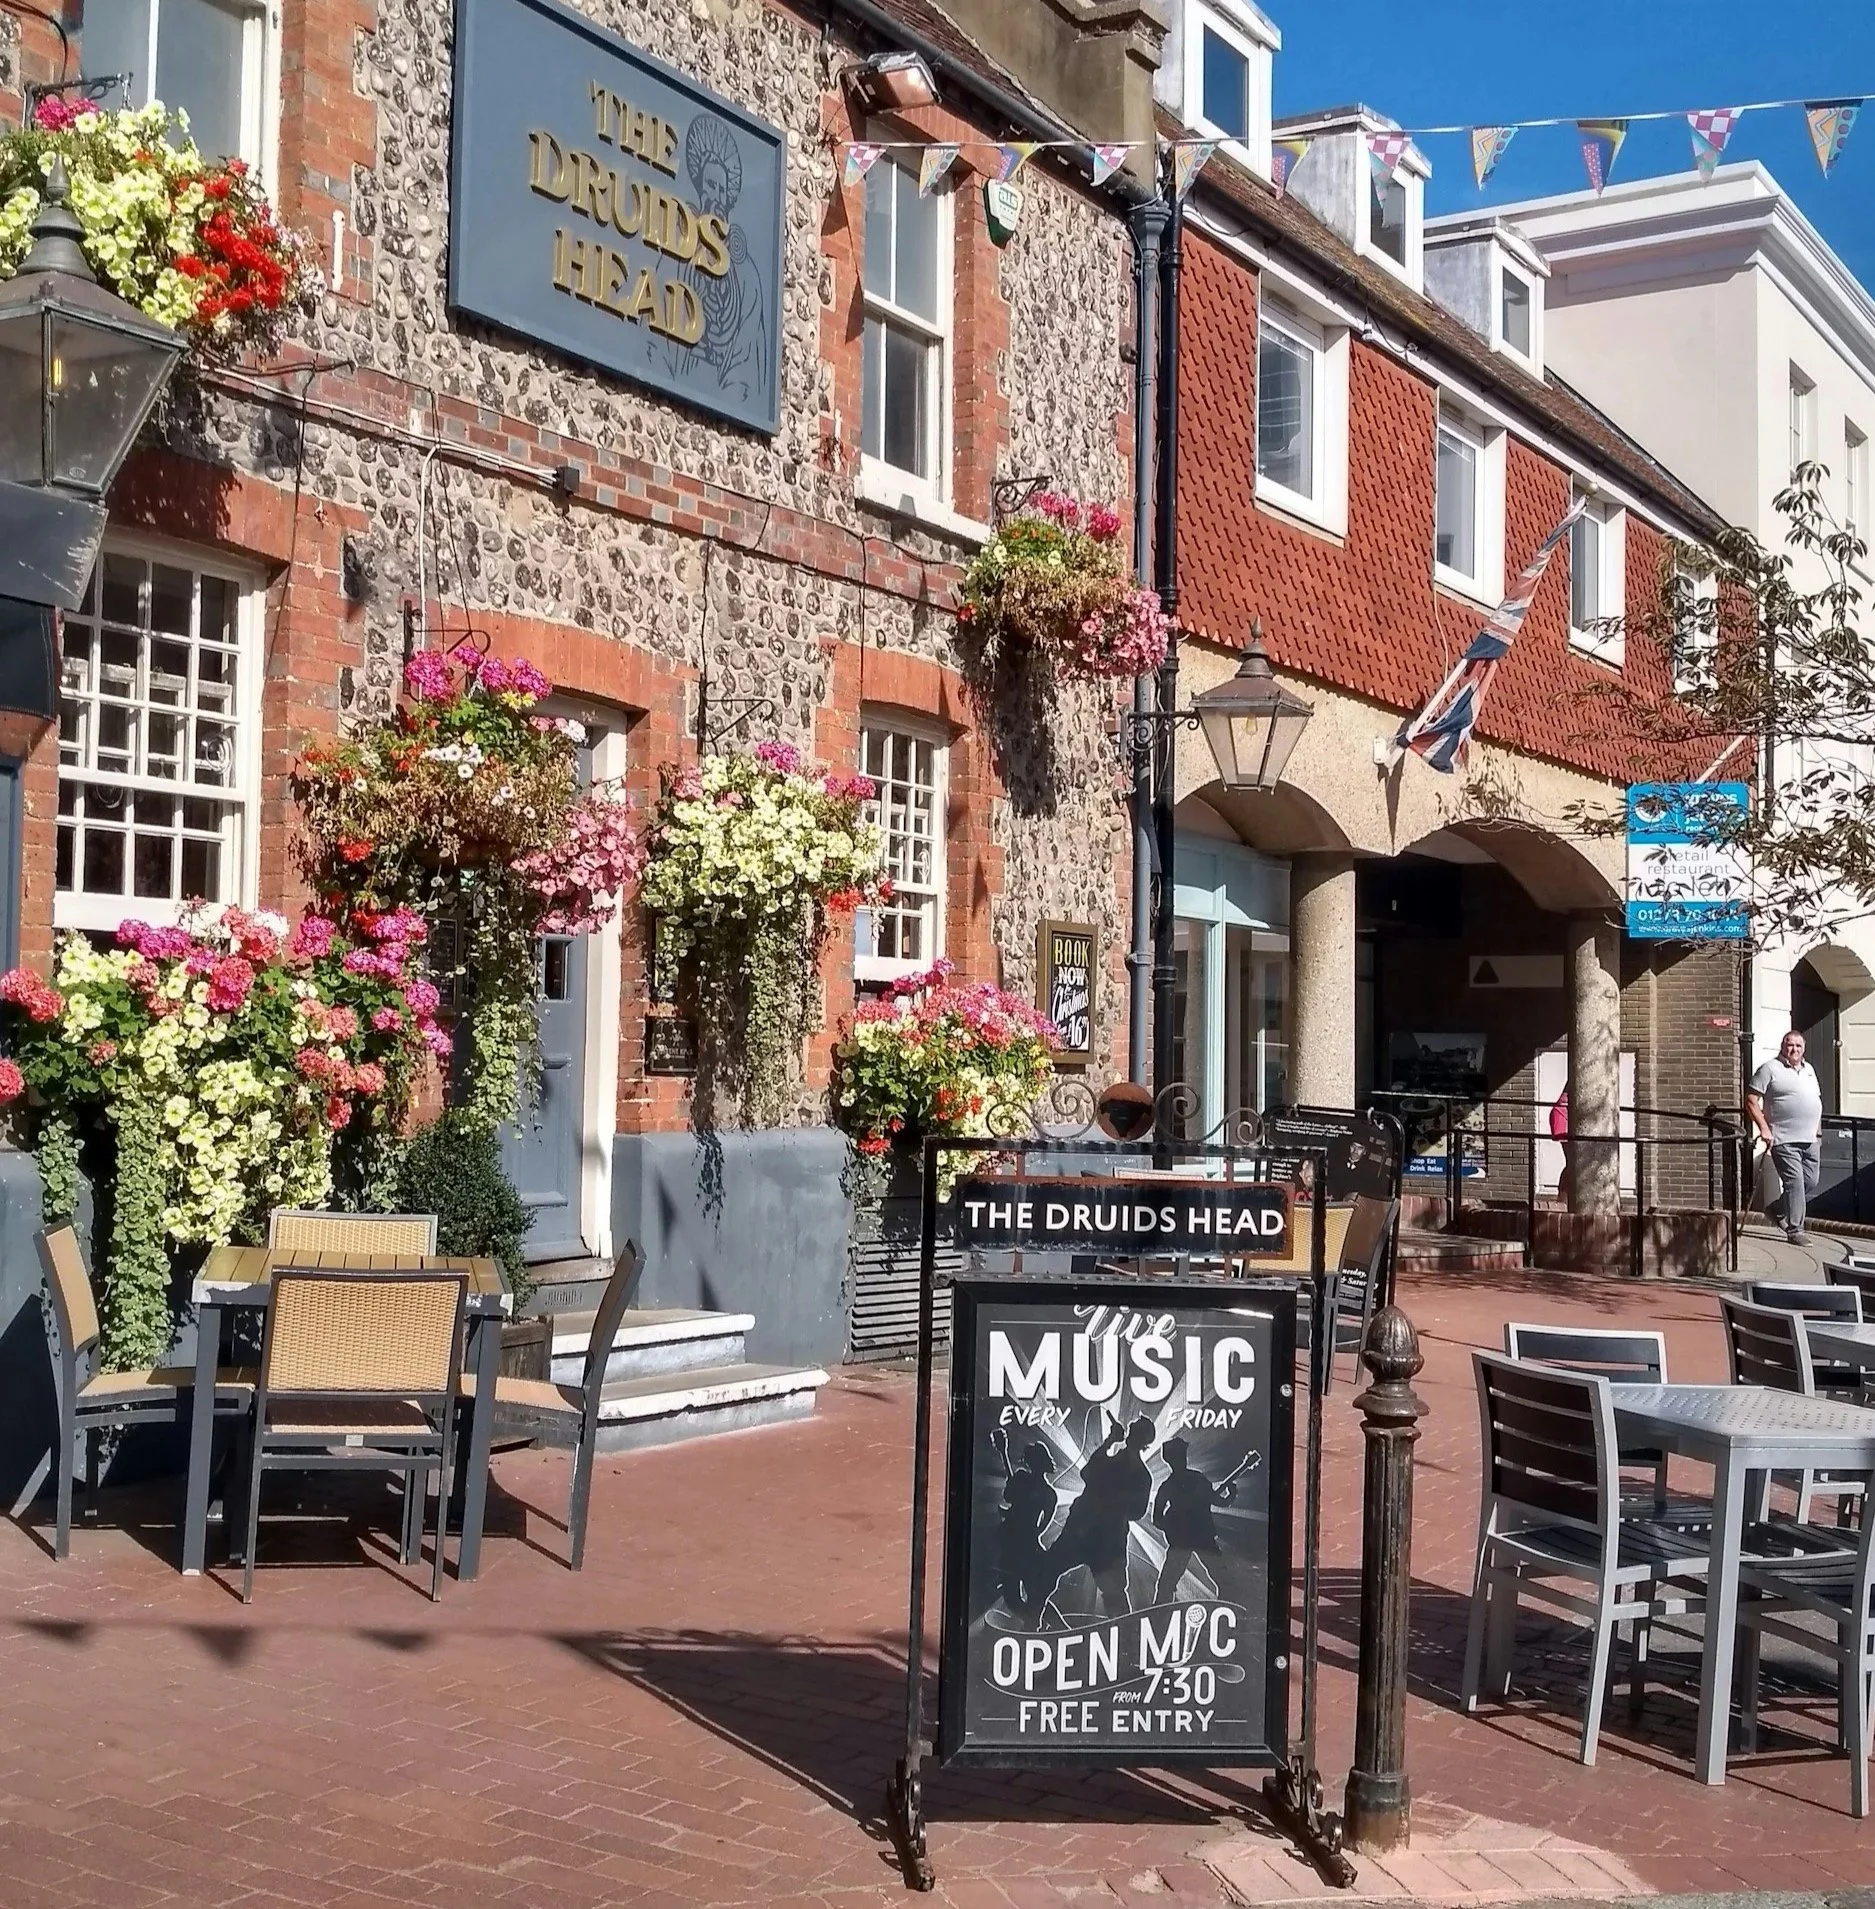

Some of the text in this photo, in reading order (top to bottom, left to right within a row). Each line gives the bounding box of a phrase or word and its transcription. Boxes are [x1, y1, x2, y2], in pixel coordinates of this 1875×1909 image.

[590, 78, 680, 179] THE
[529, 130, 730, 277] DRUIDS
[552, 227, 706, 345] HEAD
[1648, 864, 1730, 875] restaurant
[1054, 938, 1090, 967] BOOK
[1058, 966, 1086, 986] NOW
[1052, 985, 1090, 1025] Christmas
[965, 1201, 1284, 1236] THE DRUIDS HEAD
[989, 1330, 1255, 1404] MUSIC
[999, 1405, 1242, 1429] EVERY FRIDAY
[992, 1625, 1119, 1692] OPEN
[1112, 1666, 1215, 1705] FROM 7:30
[1019, 1701, 1215, 1733] FREE ENTRY
